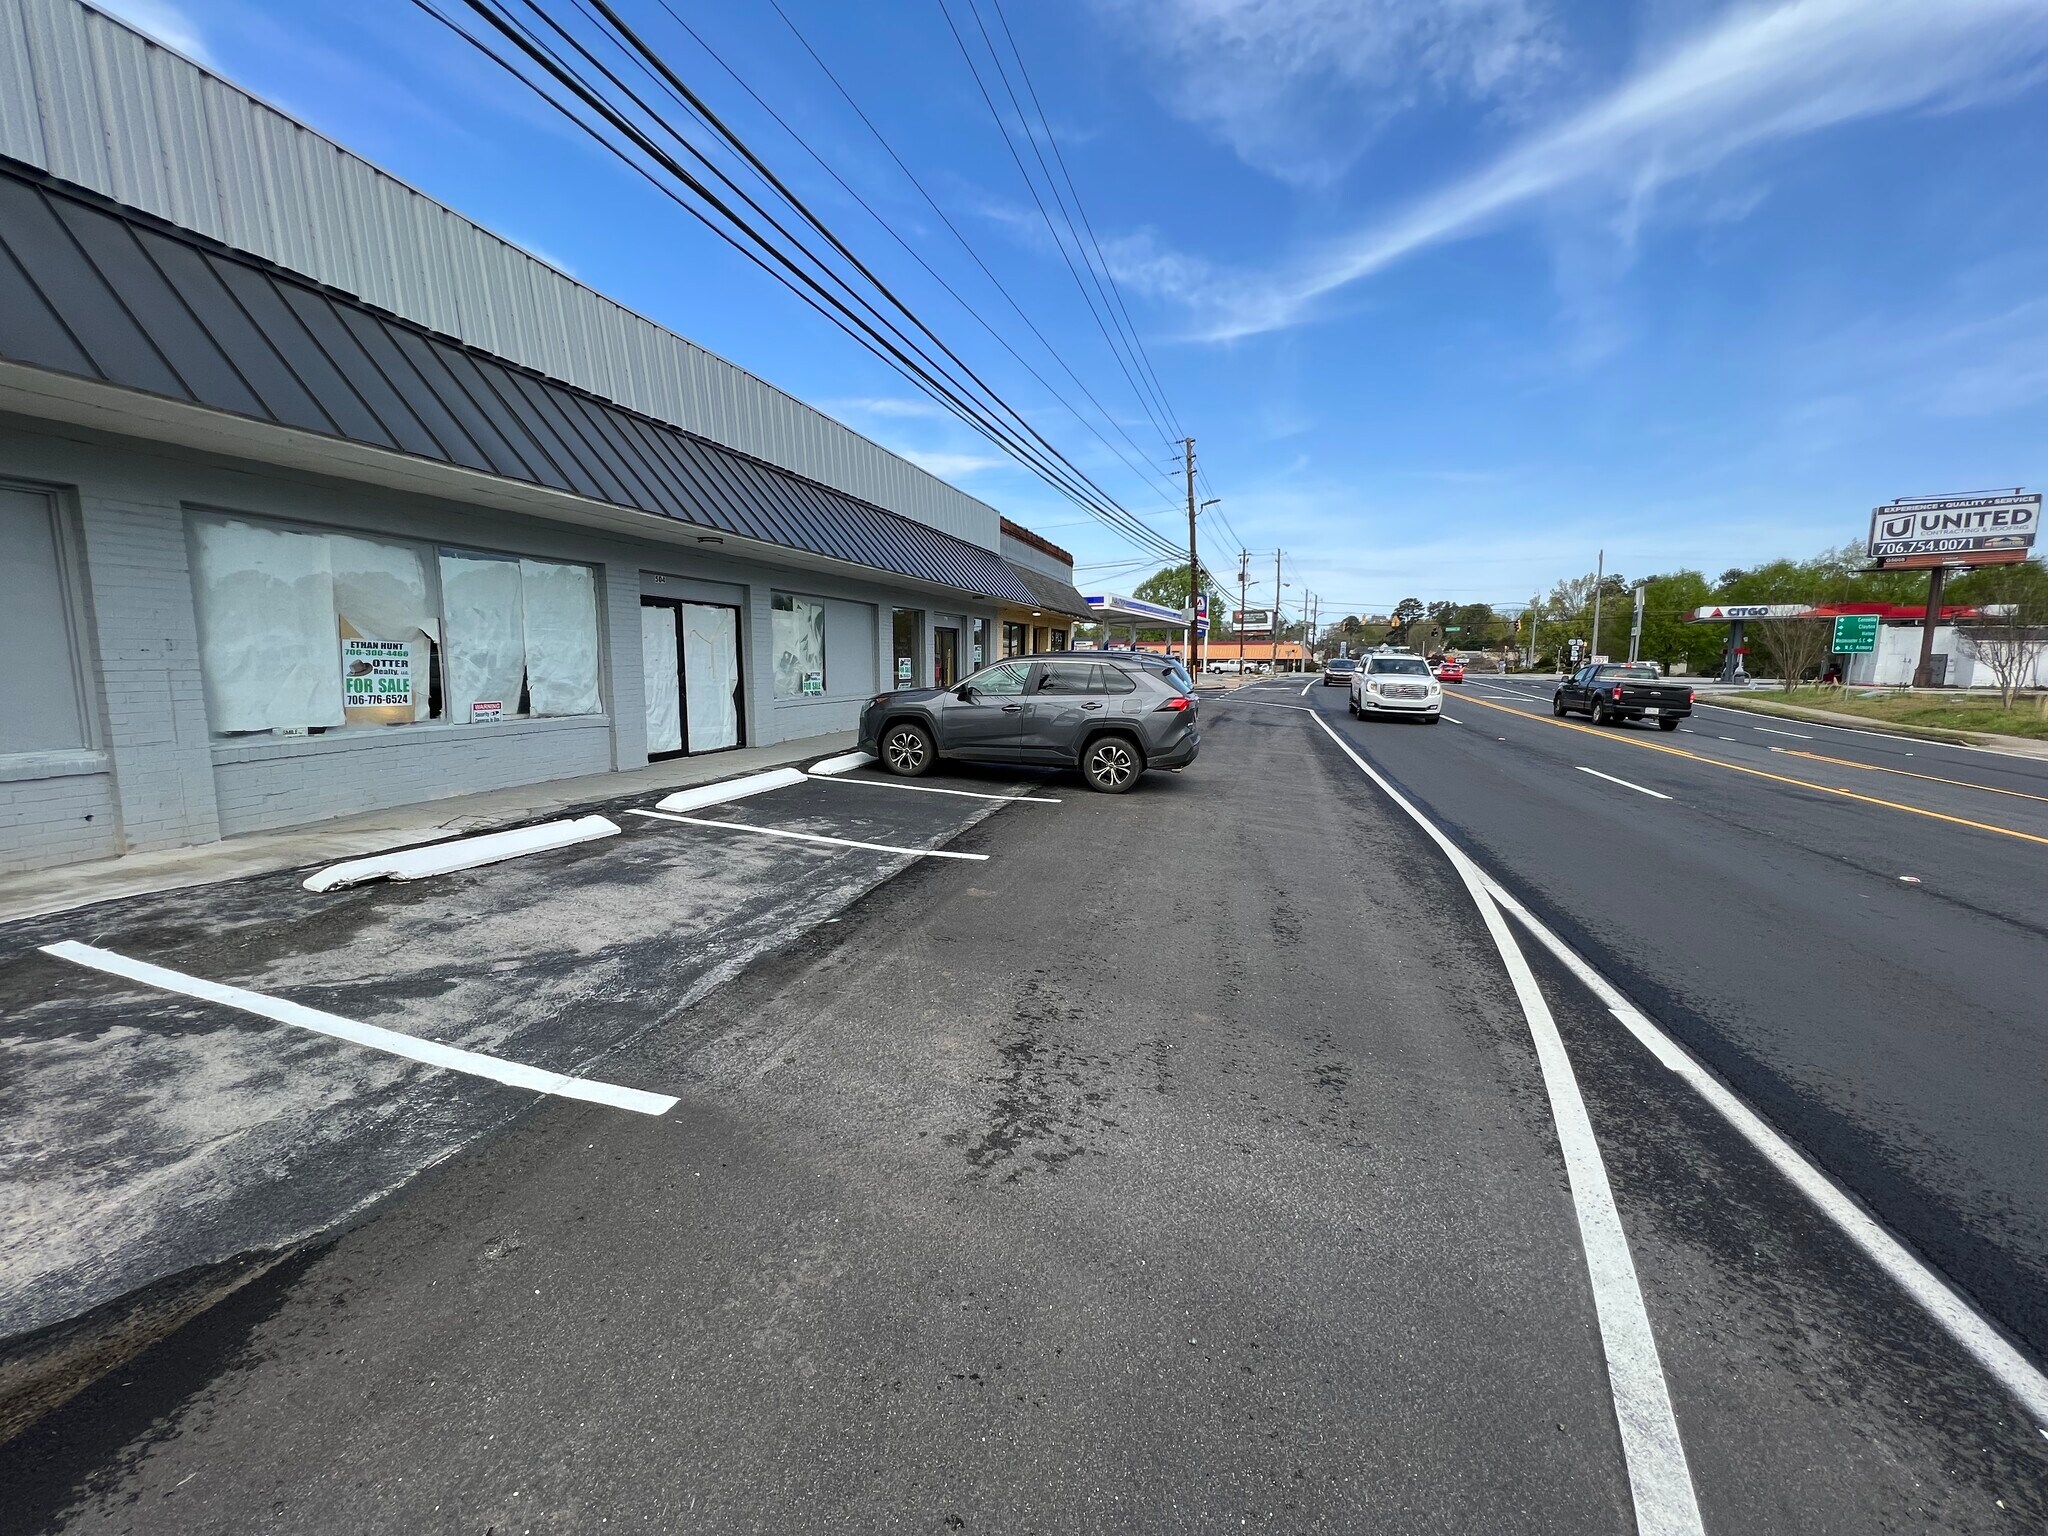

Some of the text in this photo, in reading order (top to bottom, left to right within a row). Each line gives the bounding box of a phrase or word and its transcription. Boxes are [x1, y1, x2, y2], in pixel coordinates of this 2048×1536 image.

[1883, 495, 2036, 513] EXPERIENCE QUALITY SERVICE
[1920, 508, 2033, 531] UNITED
[1920, 527, 1980, 537] CONTRACTING
[1989, 524, 2030, 533] ROOFING
[1878, 538, 1974, 555] 706.754.0071
[1727, 607, 1769, 616] CITGO
[350, 641, 404, 650] ETHAN HUNT
[372, 659, 409, 668] OTTER
[345, 677, 410, 693] FOR SALE
[347, 694, 408, 705] 706-776-6524
